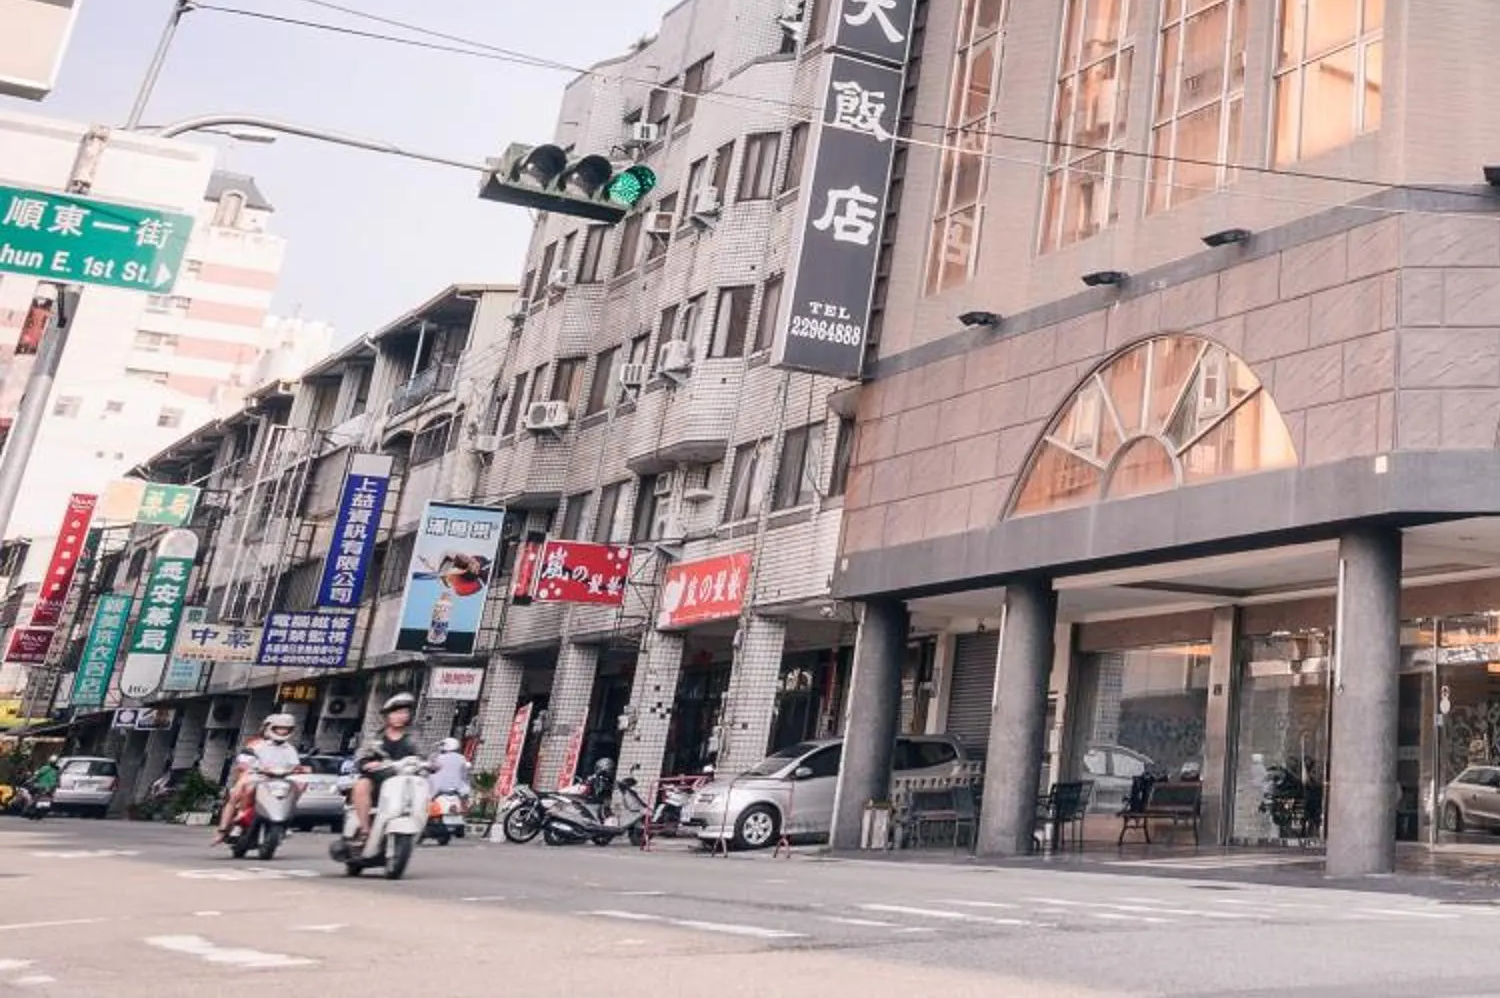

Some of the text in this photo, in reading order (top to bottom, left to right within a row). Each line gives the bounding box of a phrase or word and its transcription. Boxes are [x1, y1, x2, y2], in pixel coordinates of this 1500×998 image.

[2, 196, 174, 249] 順東一街
[51, 250, 72, 272] E.
[83, 255, 115, 278] 1st
[121, 261, 150, 284] St.
[809, 301, 850, 320] TEL
